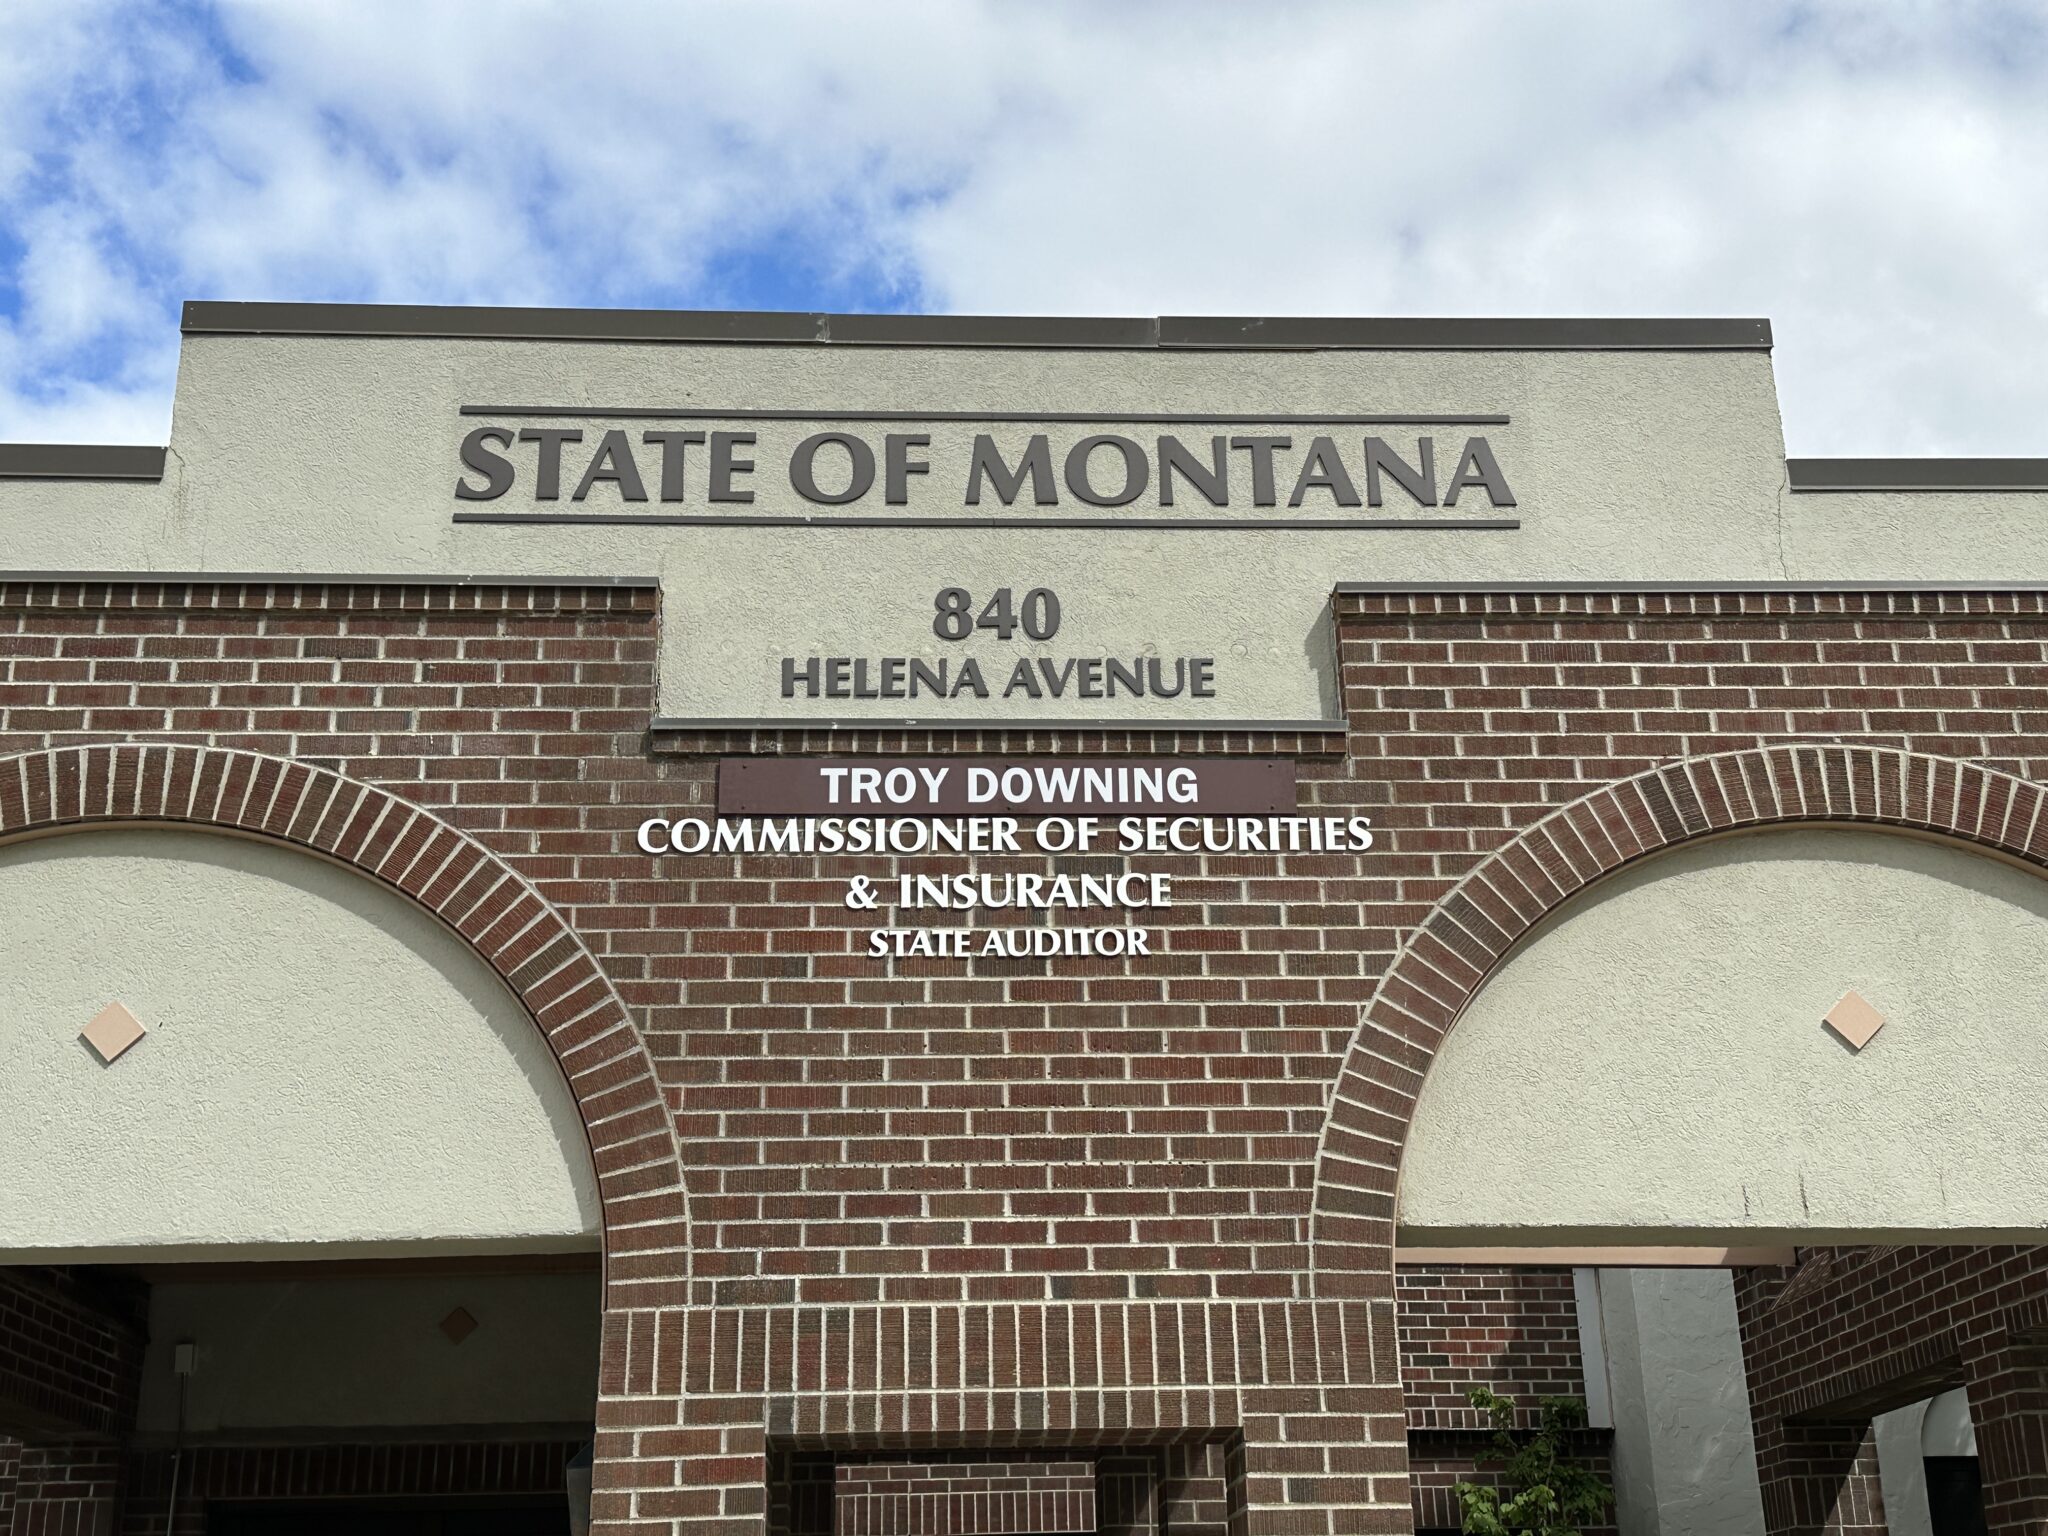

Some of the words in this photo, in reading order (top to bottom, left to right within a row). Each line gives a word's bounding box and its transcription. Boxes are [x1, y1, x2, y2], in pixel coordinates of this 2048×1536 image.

[453, 427, 757, 504] STATE
[789, 432, 931, 505] OF
[964, 433, 1517, 507] MONTANA
[932, 586, 1061, 641] 840
[780, 656, 989, 699] HELENA
[1003, 657, 1217, 698] AVENUE
[819, 766, 949, 805] TROY
[967, 766, 1200, 805] DOWNING
[636, 816, 1020, 856] COMMISSIONER
[1036, 816, 1099, 854] OF
[1117, 816, 1374, 853] SECURITIES
[844, 873, 880, 911] &
[899, 872, 1172, 910] INSURANCE
[867, 928, 972, 959] STATE
[980, 927, 1151, 957] AUDITOR
